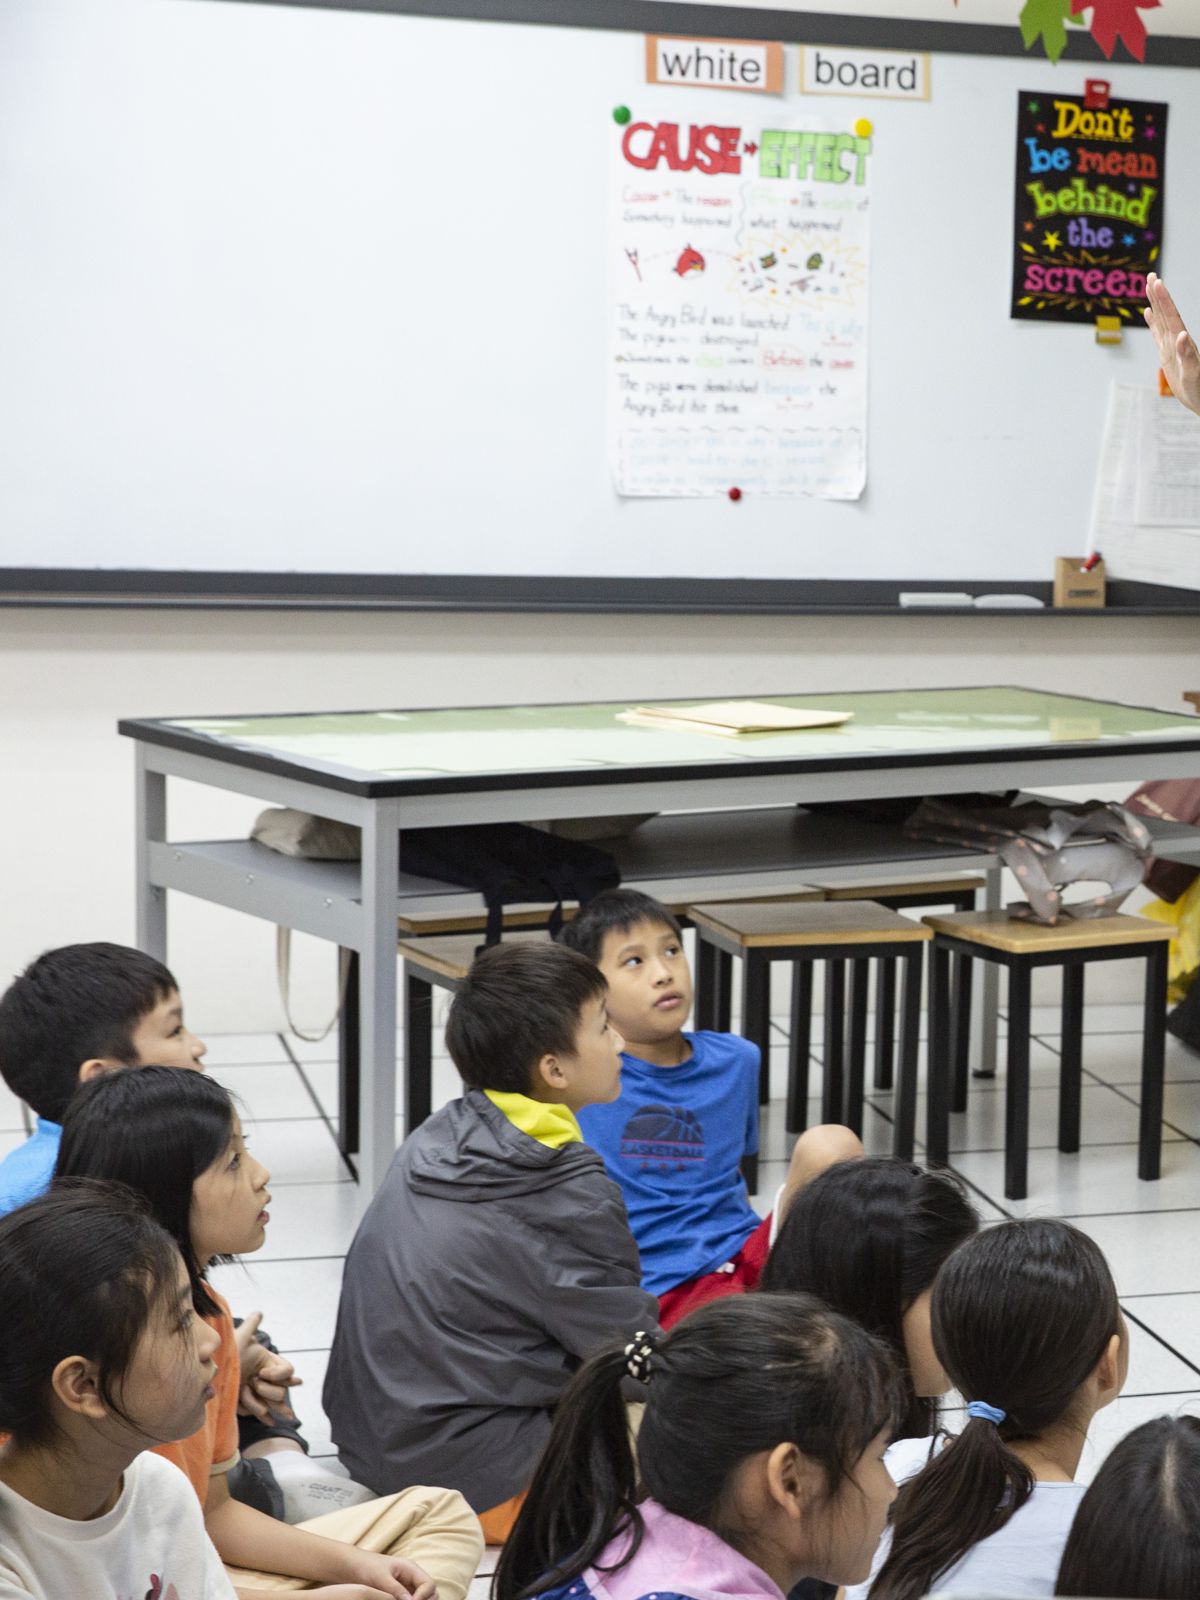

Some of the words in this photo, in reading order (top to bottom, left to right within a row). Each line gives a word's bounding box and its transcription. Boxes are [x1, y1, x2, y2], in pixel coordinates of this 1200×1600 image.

[662, 47, 761, 83] white
[815, 51, 917, 91] board
[1052, 100, 1135, 139] Don't
[621, 121, 742, 175] CAUSE
[759, 128, 872, 185] EFFECT
[1024, 137, 1071, 174] be
[1076, 147, 1157, 179] mean
[1025, 177, 1157, 228] behind
[1066, 216, 1114, 248] the
[1023, 264, 1147, 298] screen
